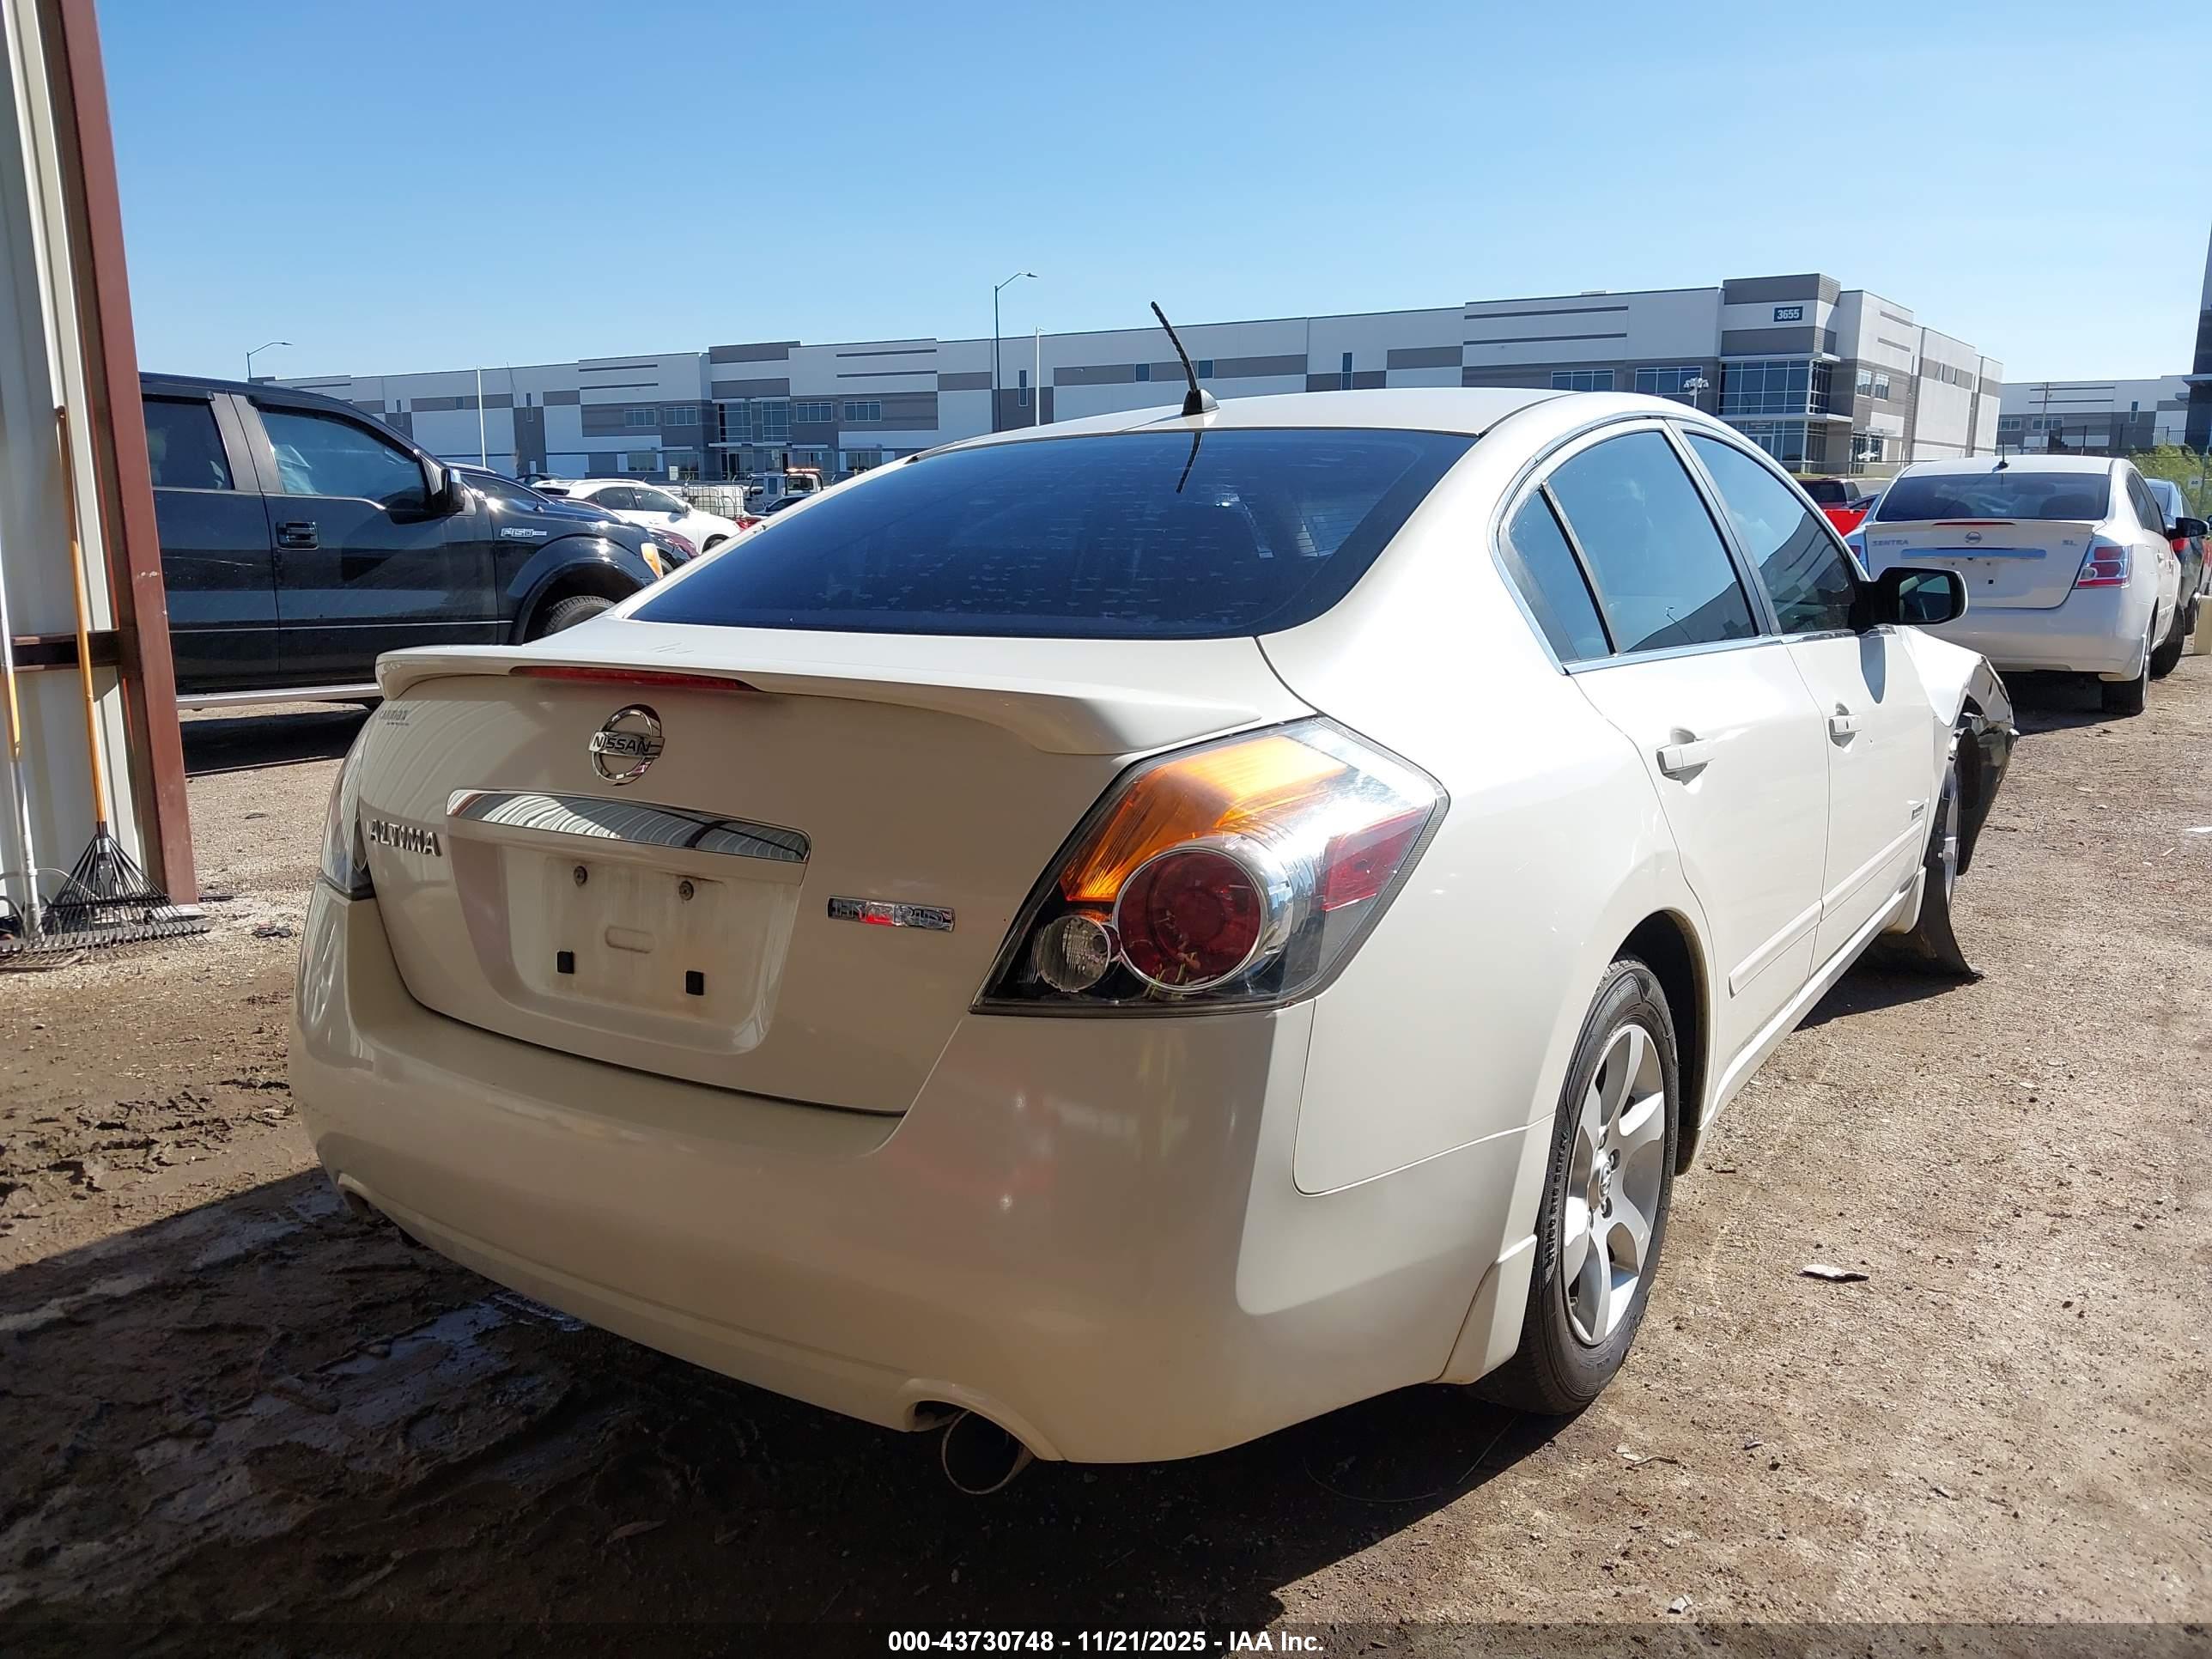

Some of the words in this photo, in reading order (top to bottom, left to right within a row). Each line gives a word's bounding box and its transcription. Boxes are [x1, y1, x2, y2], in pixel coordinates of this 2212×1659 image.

[1777, 308, 1800, 319] 3655
[592, 735, 652, 753] NISSAN
[369, 819, 442, 857] ALTIMA
